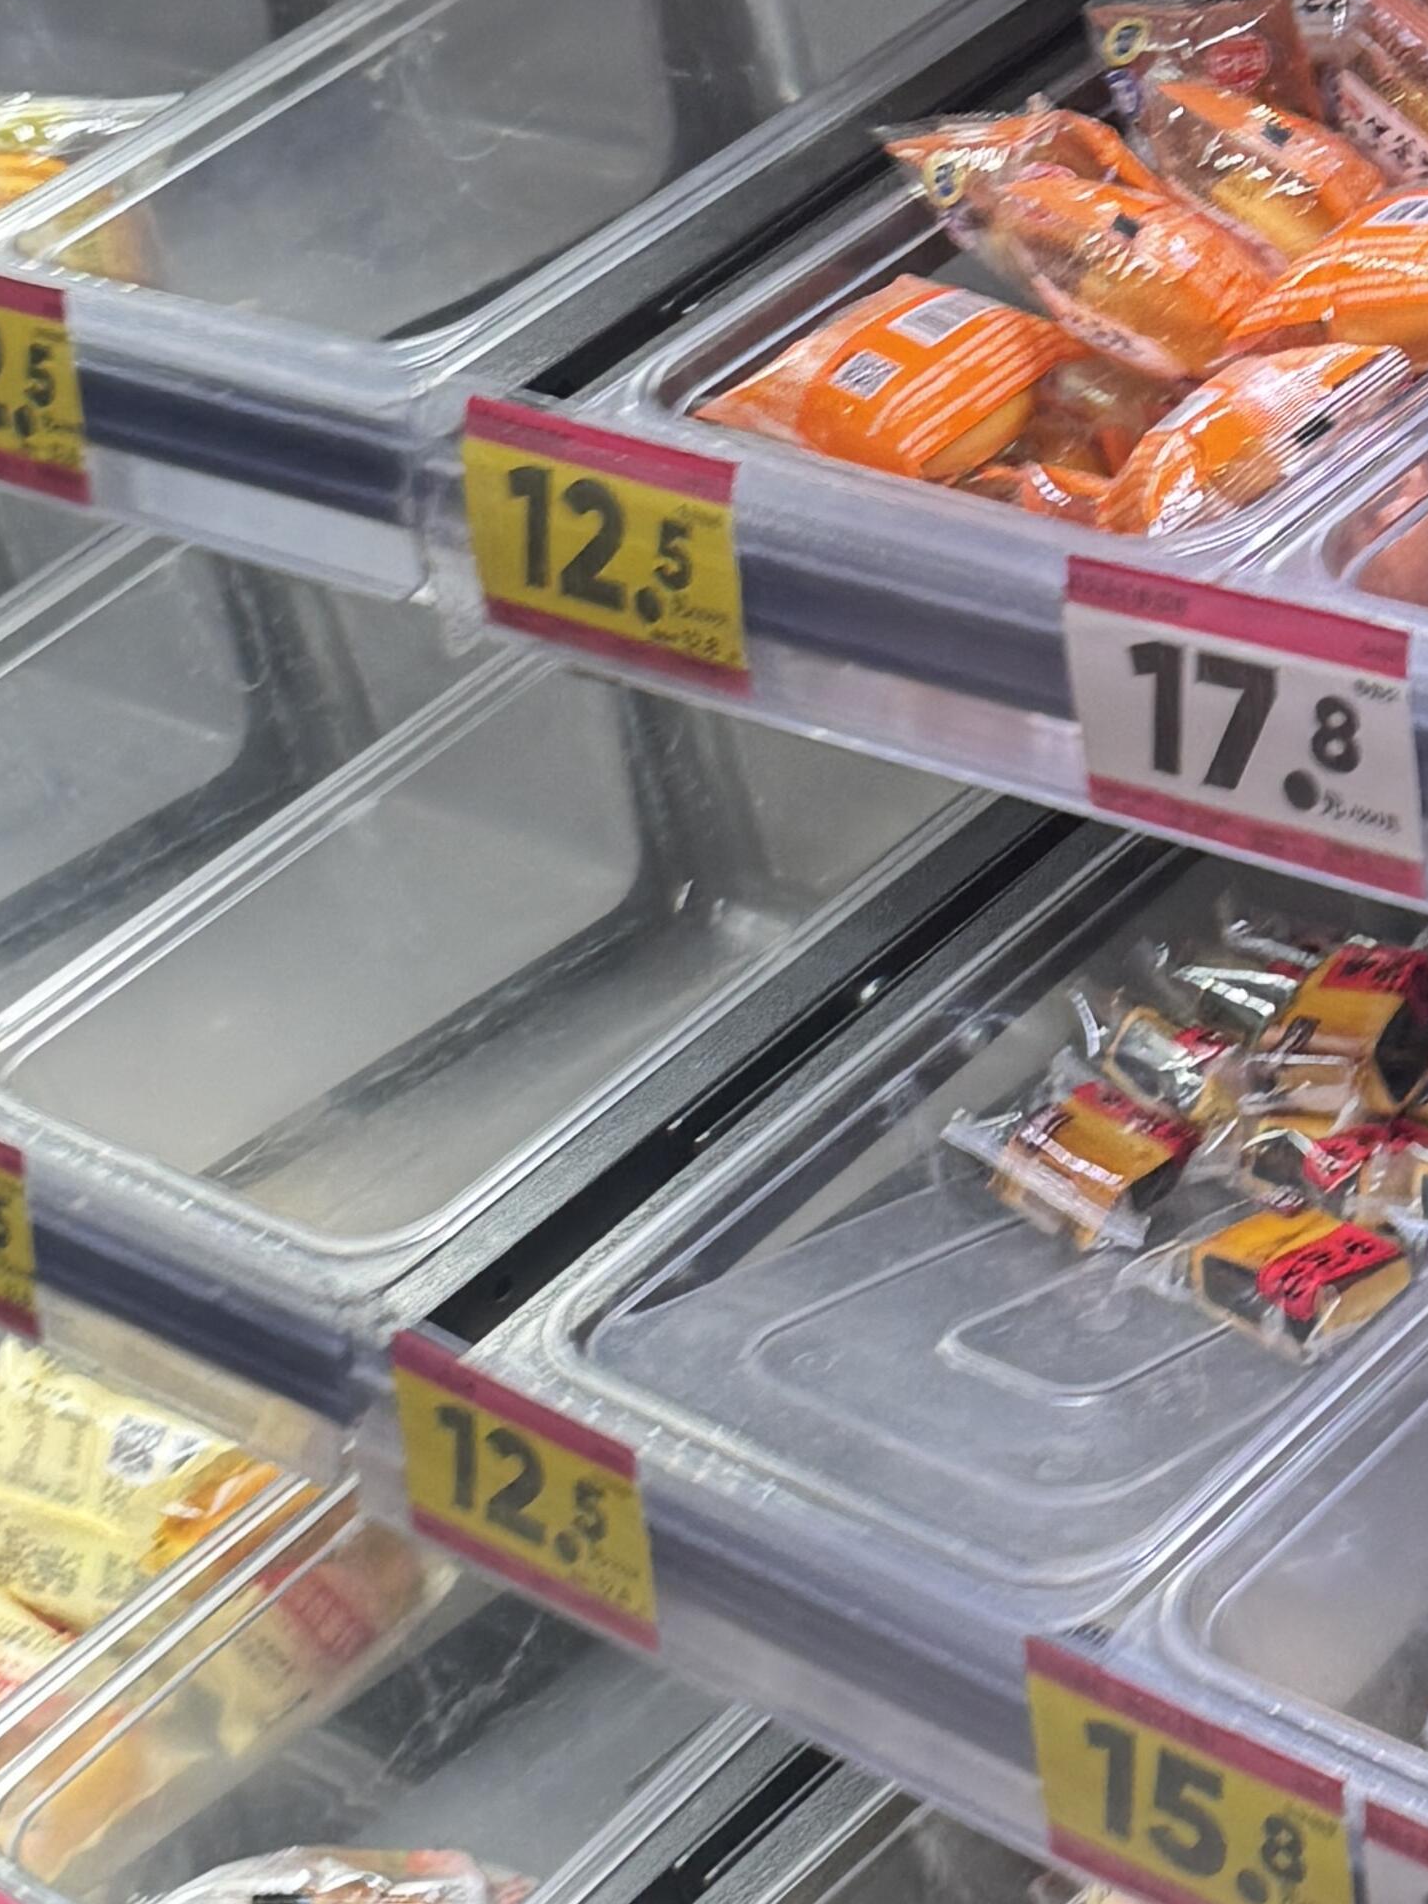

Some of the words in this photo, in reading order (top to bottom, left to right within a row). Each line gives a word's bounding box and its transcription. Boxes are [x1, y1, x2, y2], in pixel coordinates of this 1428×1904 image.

[507, 464, 692, 623] 12.5
[1129, 640, 1362, 812] 17.8
[436, 1405, 608, 1564] 12.5
